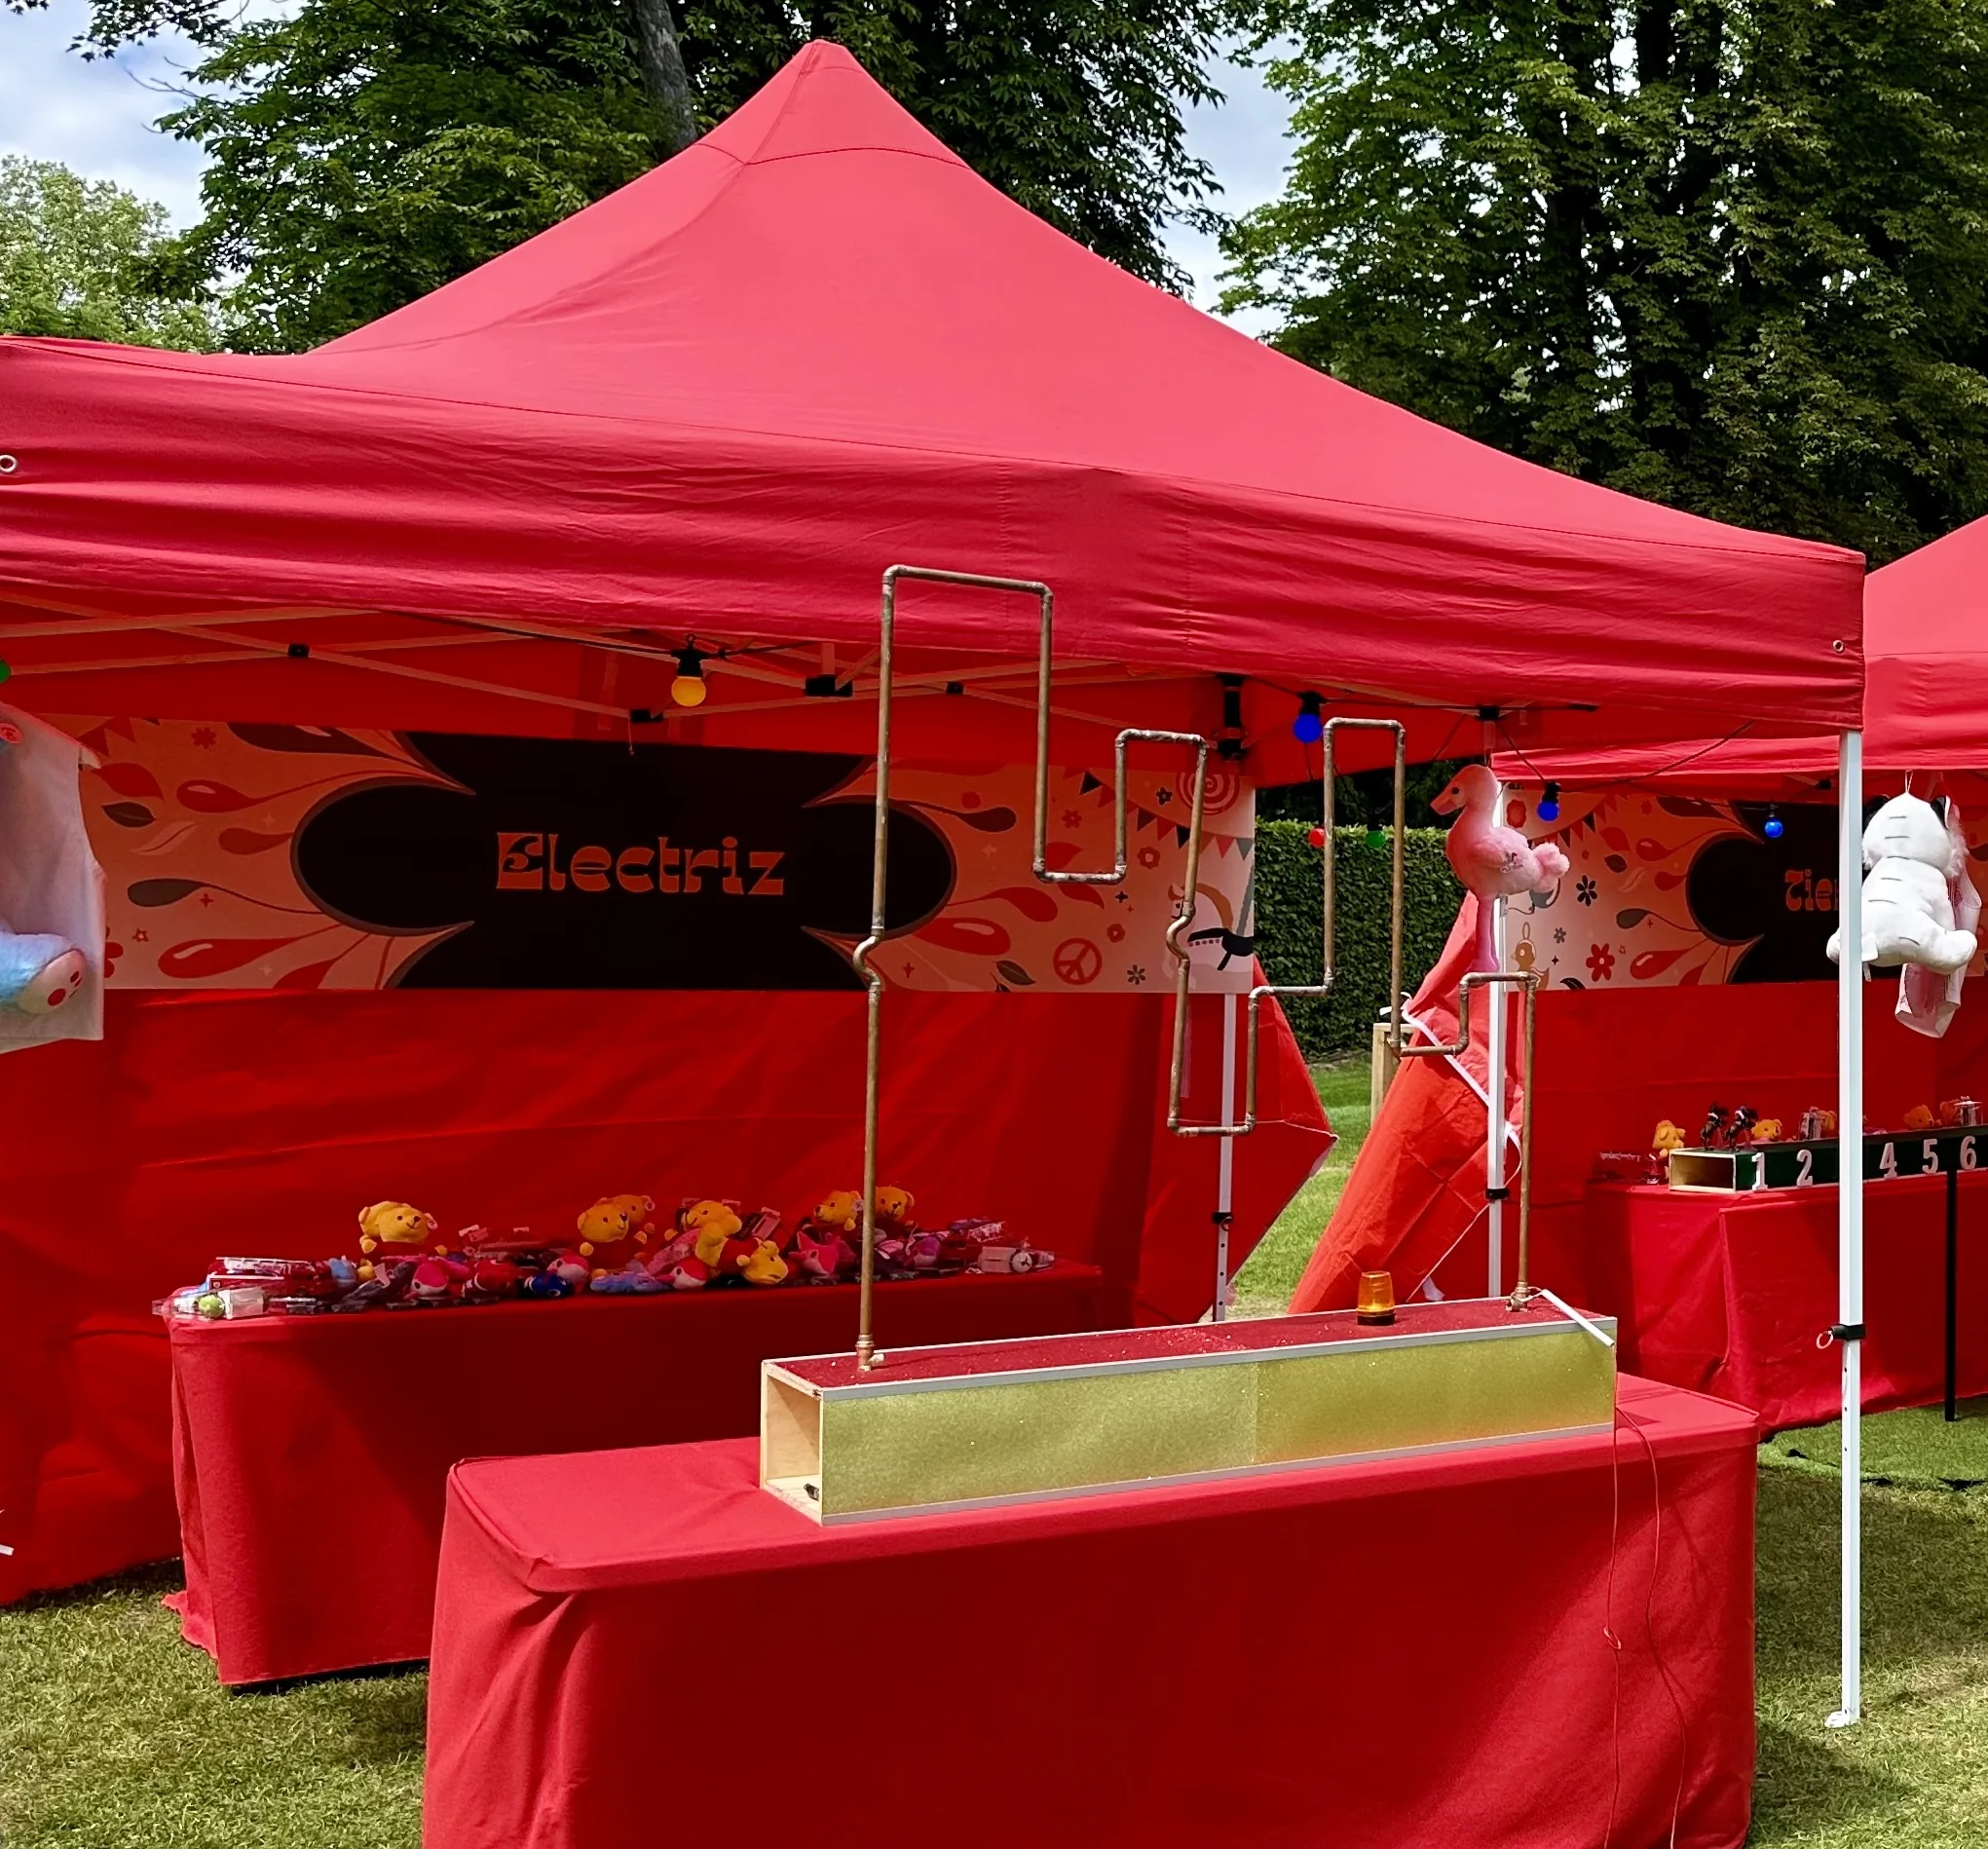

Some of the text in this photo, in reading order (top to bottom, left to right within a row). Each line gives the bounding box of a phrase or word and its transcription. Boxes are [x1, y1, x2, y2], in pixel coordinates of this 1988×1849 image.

[496, 832, 785, 895] Electriz
[1751, 1135, 1977, 1191] 1 2 4 5 6
